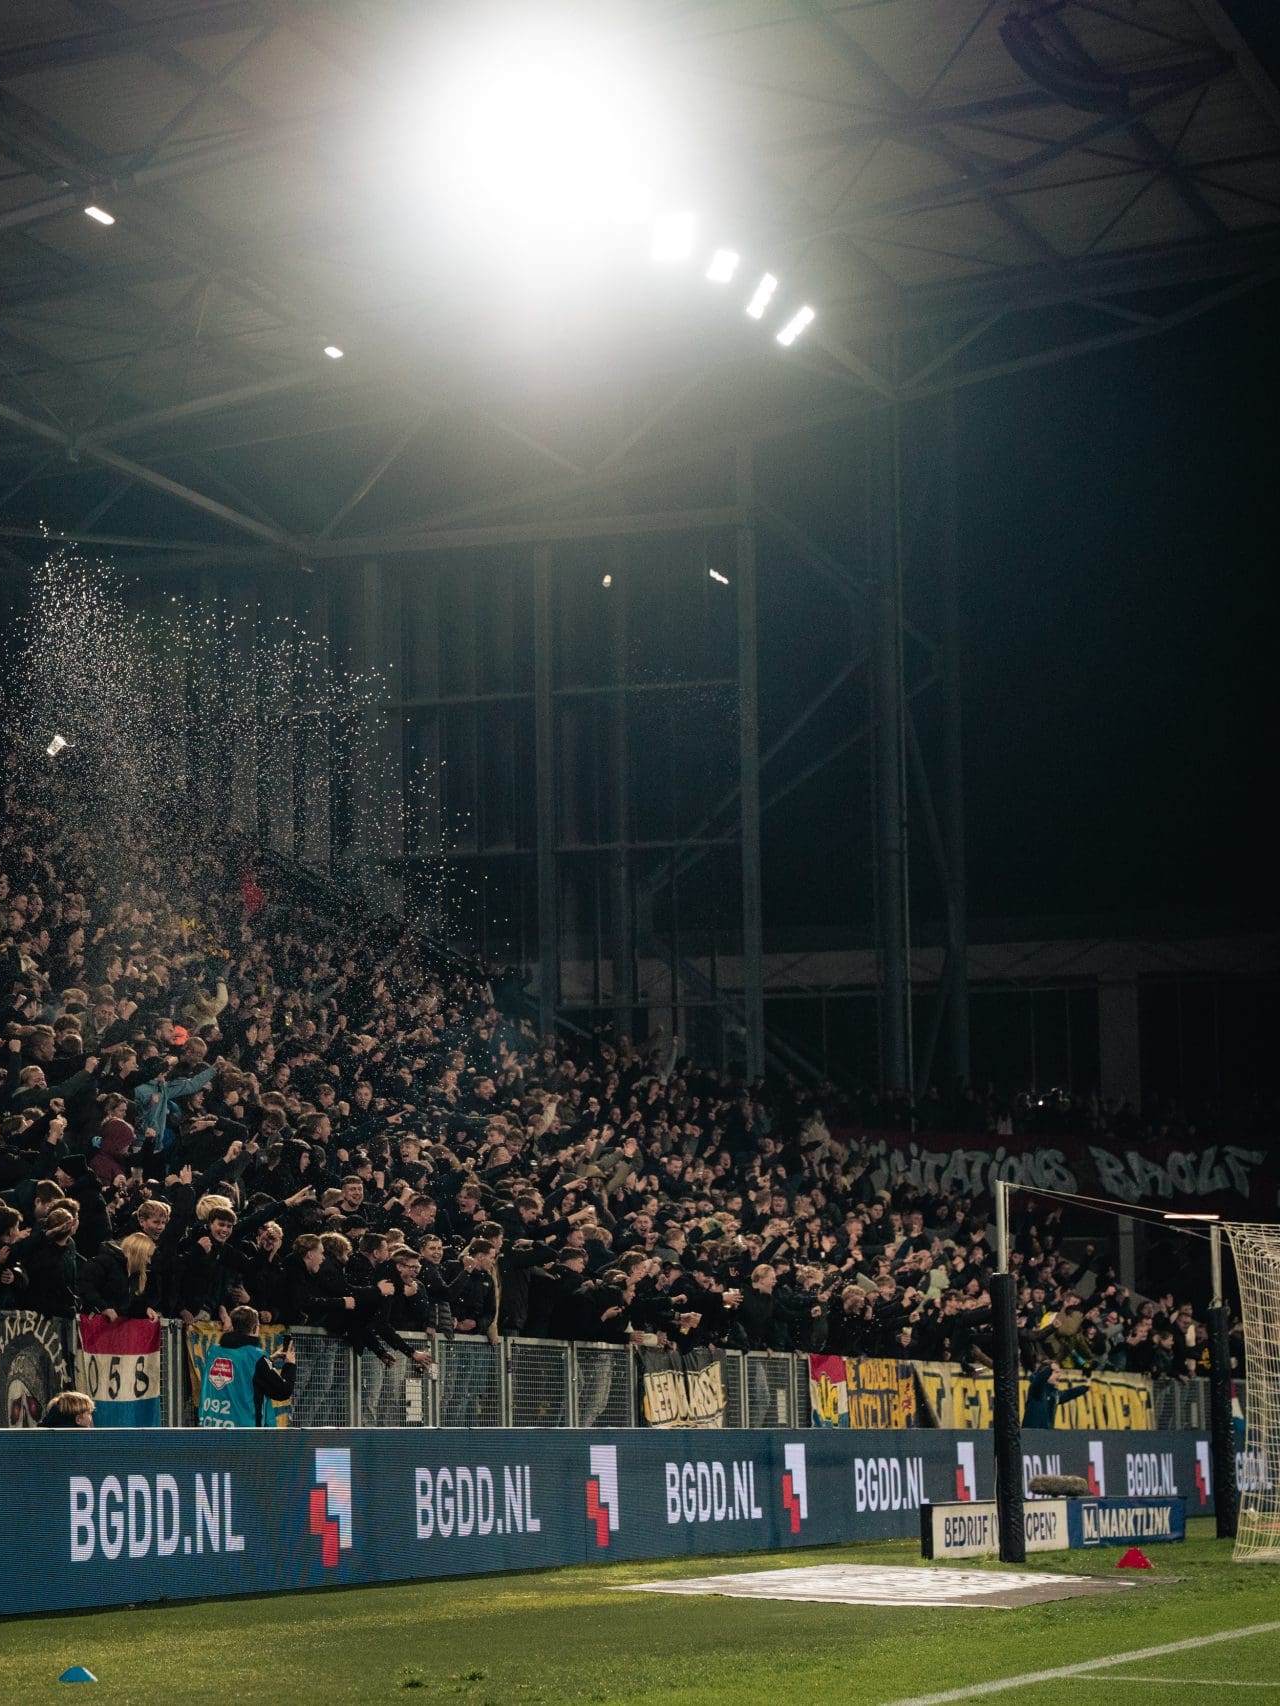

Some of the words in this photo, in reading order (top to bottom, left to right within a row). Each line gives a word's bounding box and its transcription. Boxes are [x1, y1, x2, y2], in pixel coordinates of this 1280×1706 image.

[88, 1354, 150, 1400] 058
[199, 1415, 235, 1428] OTO
[203, 1396, 232, 1415] 092
[665, 1460, 763, 1524] BGDD.NL
[854, 1457, 929, 1513] BGDD.NL
[1022, 1454, 1067, 1500] DD.NL
[1126, 1453, 1178, 1497] BGDD.NL
[69, 1472, 246, 1562] BGDD.NL
[415, 1465, 541, 1539] BGDD.NL
[1099, 1506, 1172, 1538] MARKTLINK
[944, 1514, 988, 1548] BEDRIJF
